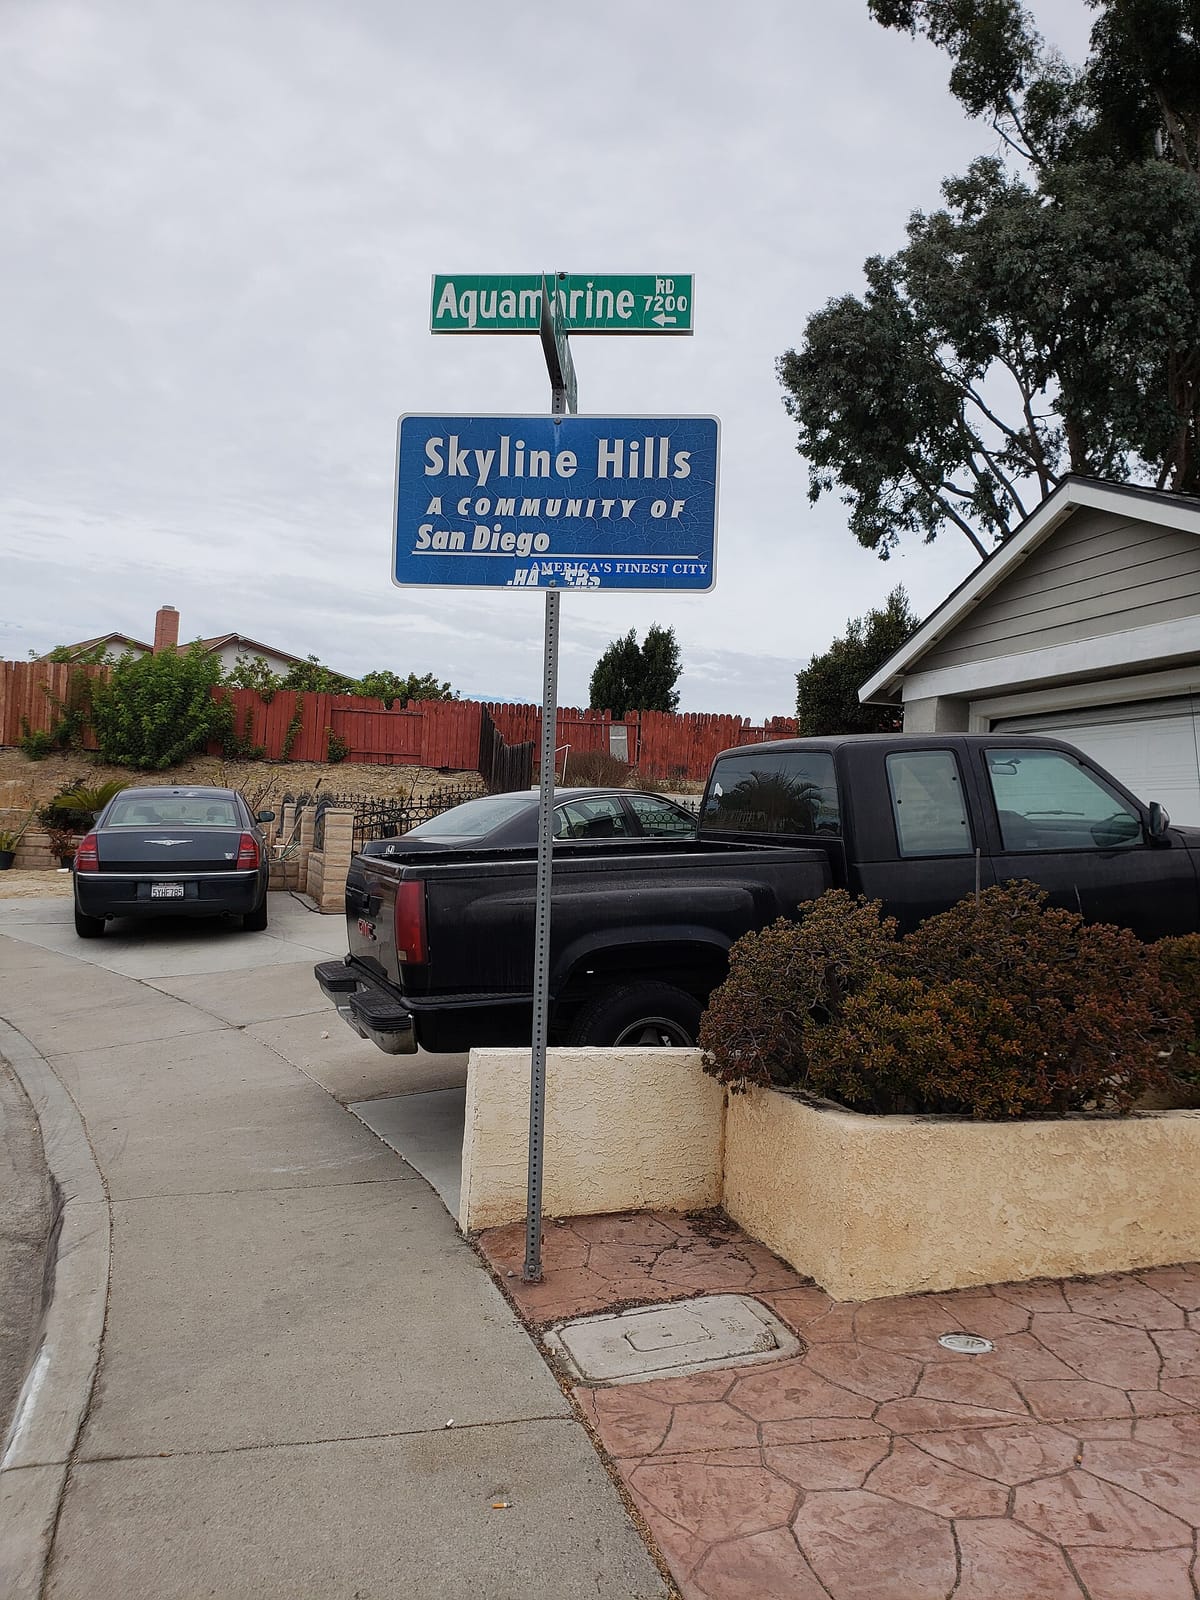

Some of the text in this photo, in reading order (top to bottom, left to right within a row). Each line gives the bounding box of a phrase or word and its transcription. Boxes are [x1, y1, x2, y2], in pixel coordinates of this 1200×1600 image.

[656, 279, 675, 295] RD
[643, 295, 688, 312] 7200
[424, 435, 692, 486] Skyline Hills
[426, 497, 686, 518] A COMMUNITY OF
[416, 523, 550, 557] San Diego
[531, 561, 708, 575] AMERICA'S FINEST CITY
